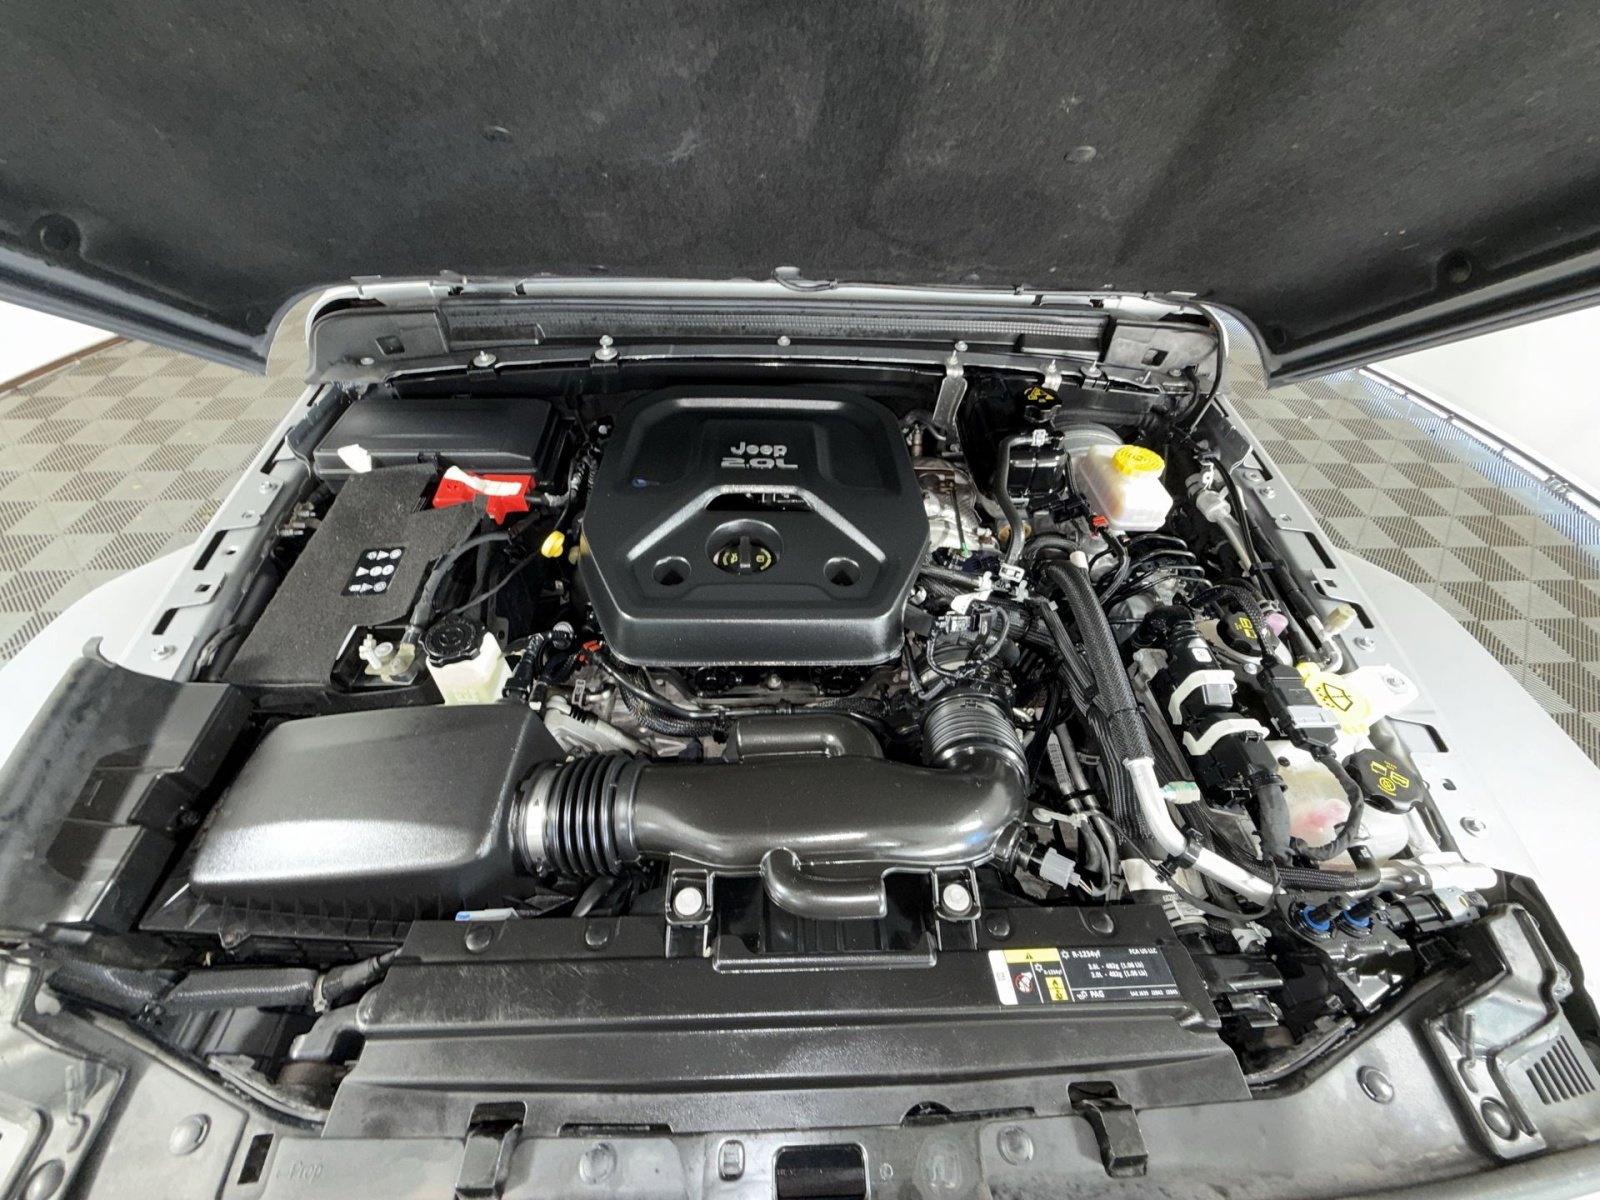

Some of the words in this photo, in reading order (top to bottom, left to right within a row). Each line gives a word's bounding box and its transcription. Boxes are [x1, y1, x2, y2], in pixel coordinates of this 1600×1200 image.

[730, 441, 788, 457] Jeep
[720, 457, 799, 469] 2.0L
[1071, 950, 1101, 959] R-1234yf
[1089, 990, 1105, 998] PAG
